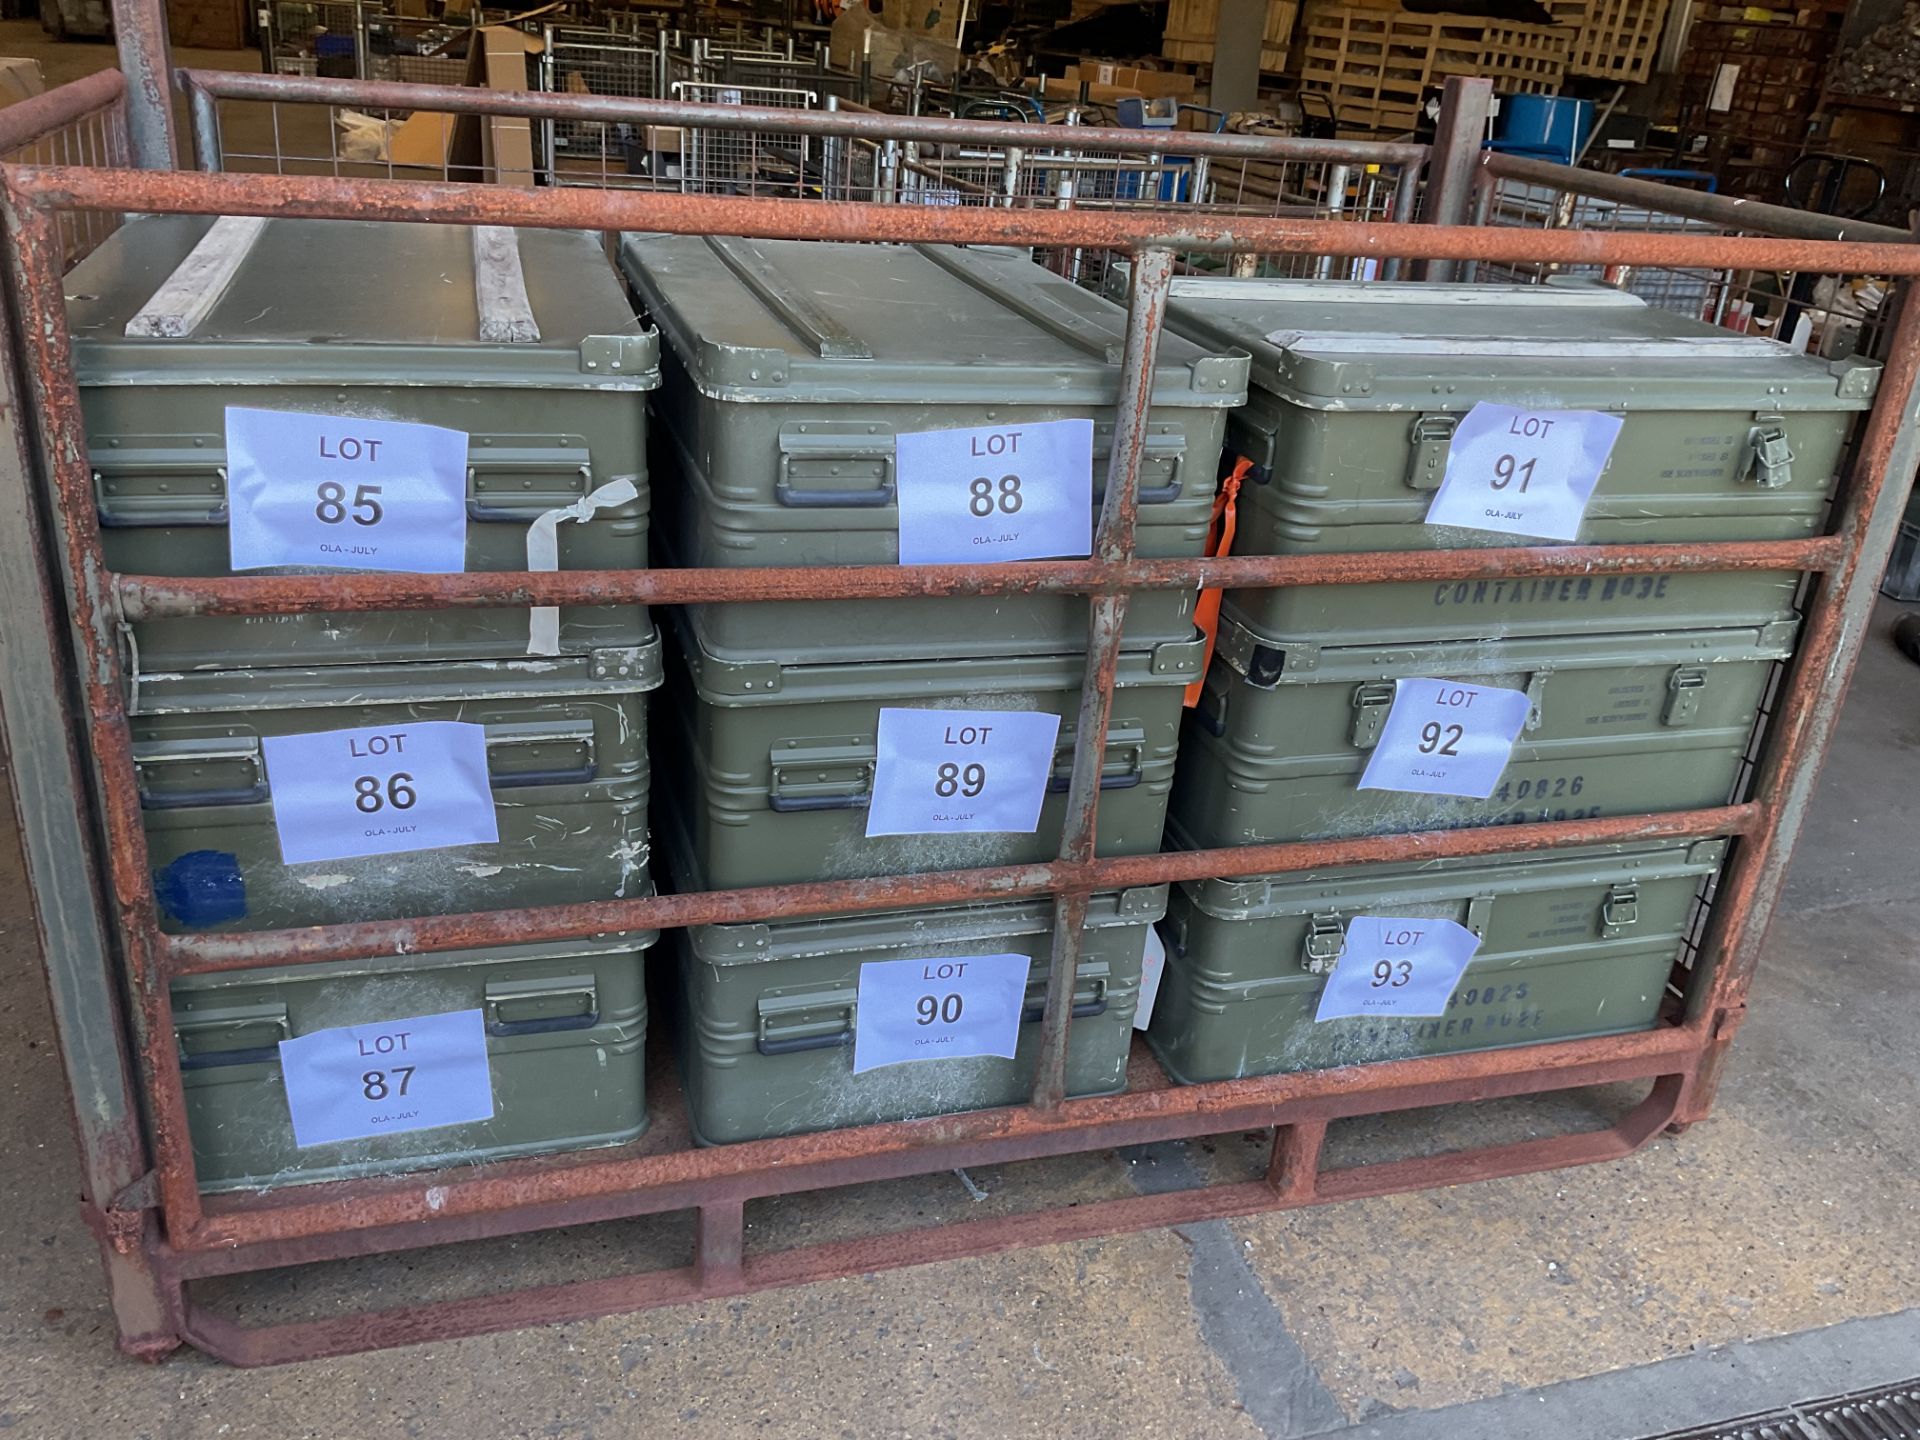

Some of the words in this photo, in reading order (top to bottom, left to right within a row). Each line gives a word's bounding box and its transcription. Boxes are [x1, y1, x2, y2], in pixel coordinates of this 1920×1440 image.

[1509, 415, 1554, 439] LOT
[320, 436, 383, 462] LOT
[971, 432, 1022, 456] LOT
[1490, 454, 1538, 494] 91
[315, 481, 384, 527] 85
[969, 474, 1023, 517] 88
[1434, 578, 1592, 606] CONTAINER
[1436, 687, 1478, 708] LOT
[349, 733, 407, 758] LOT
[944, 726, 992, 745] LOT
[1418, 721, 1464, 757] 92
[354, 772, 417, 814] 86
[935, 762, 986, 798] 89
[1384, 931, 1424, 946] LOT
[923, 963, 968, 980] LOT
[1371, 959, 1413, 988] 93
[916, 992, 963, 1026] 90
[358, 1032, 411, 1057] LOT
[361, 1065, 416, 1101] 87
